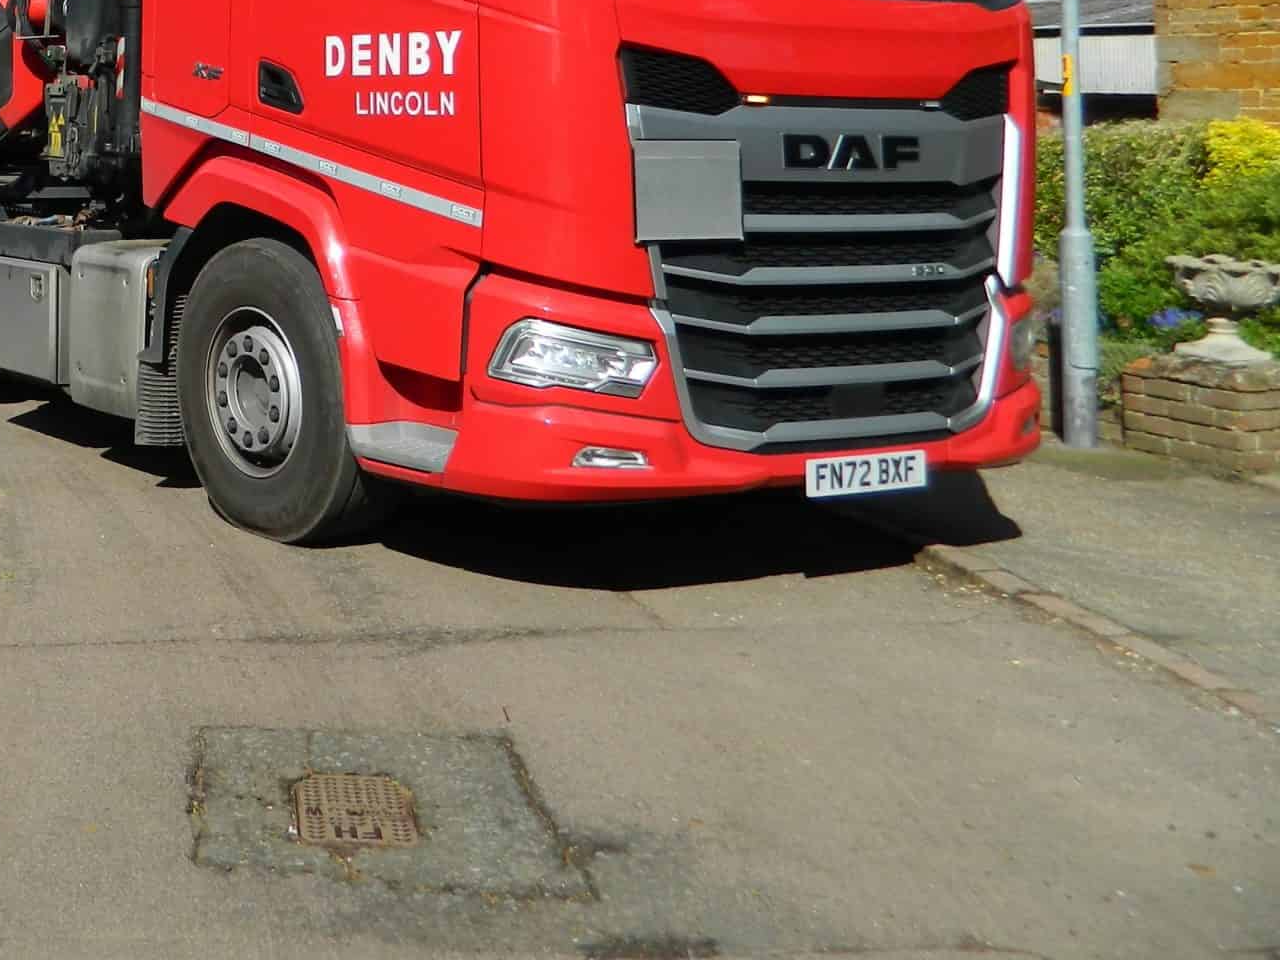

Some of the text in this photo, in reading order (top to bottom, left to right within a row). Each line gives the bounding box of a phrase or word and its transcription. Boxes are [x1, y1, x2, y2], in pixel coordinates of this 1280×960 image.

[325, 30, 463, 77] DENBY
[356, 91, 455, 116] LINCOLN
[781, 133, 920, 169] DAF
[816, 456, 917, 490] FN72 BXF
